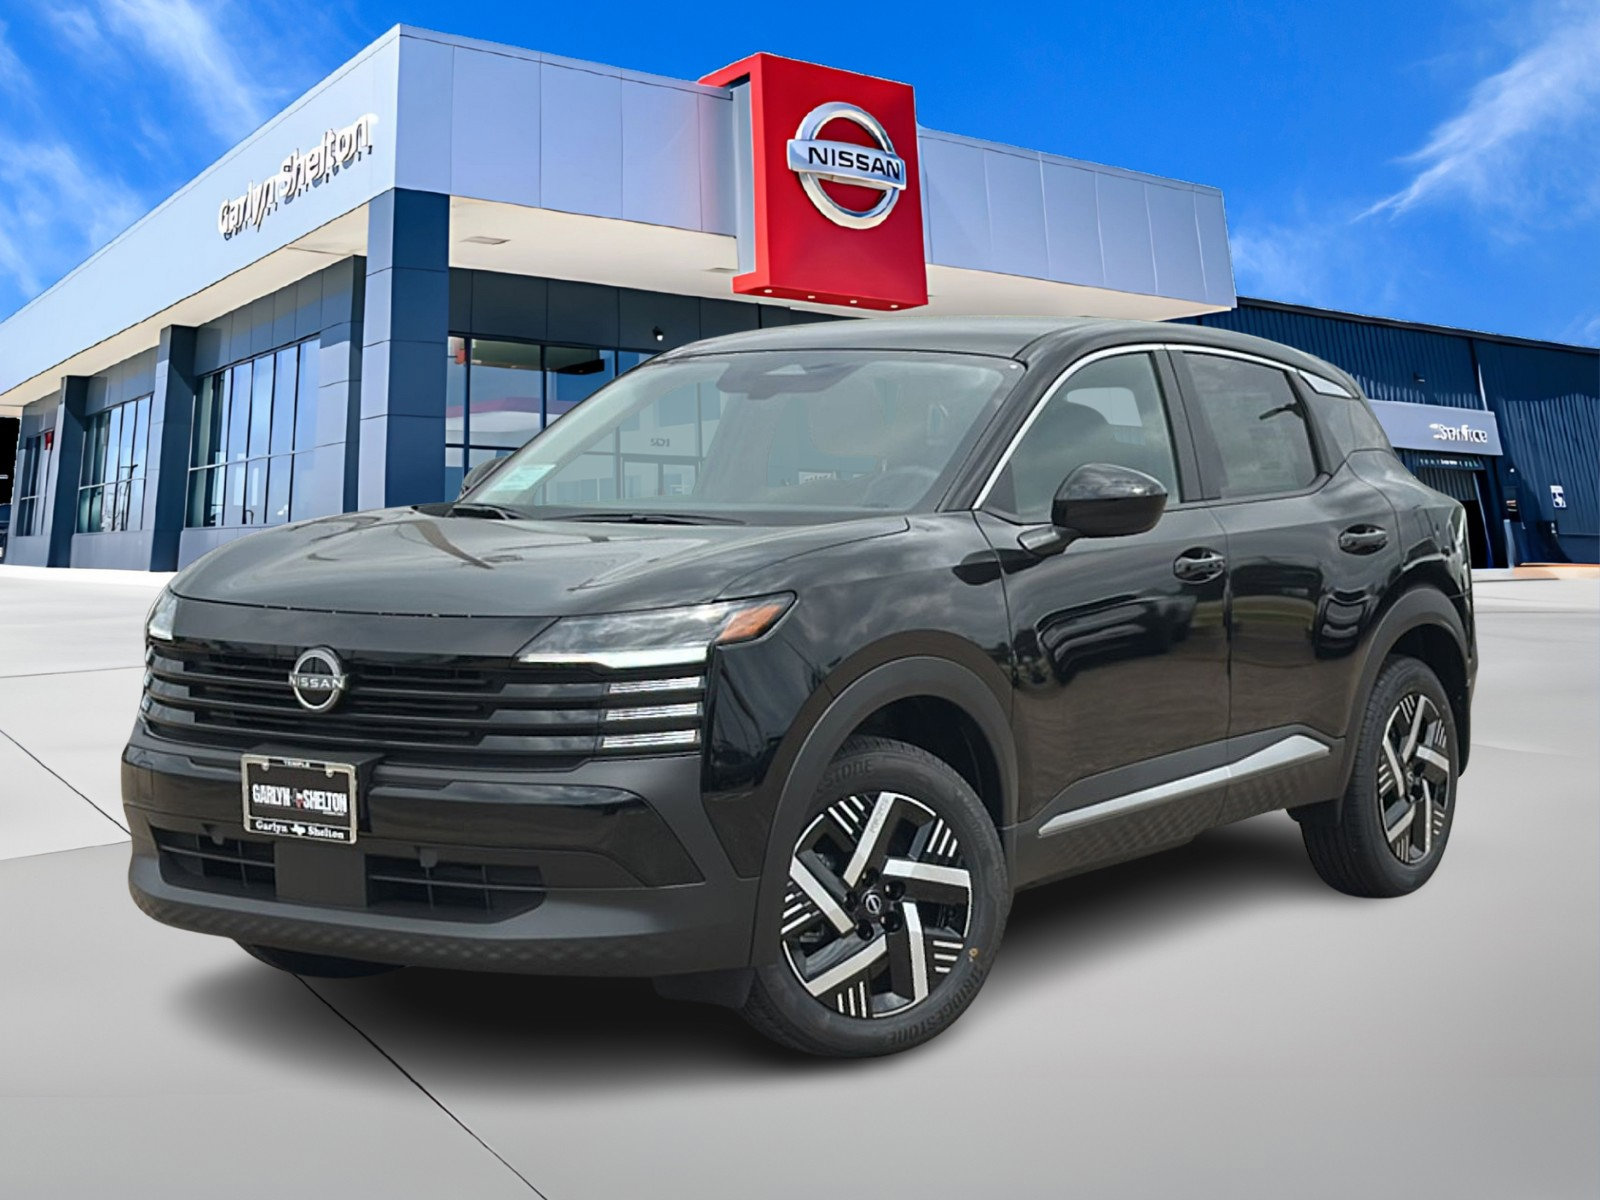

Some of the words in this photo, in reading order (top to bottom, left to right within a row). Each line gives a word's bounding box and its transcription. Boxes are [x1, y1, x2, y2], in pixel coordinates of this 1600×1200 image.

[278, 114, 375, 203] Shelton
[808, 146, 900, 180] NISSAN
[288, 672, 346, 690] NISSAN
[252, 783, 291, 807] GARLYN
[302, 789, 348, 813] SHELTON
[255, 820, 288, 834] Garlyn
[307, 825, 344, 840] Shelton
